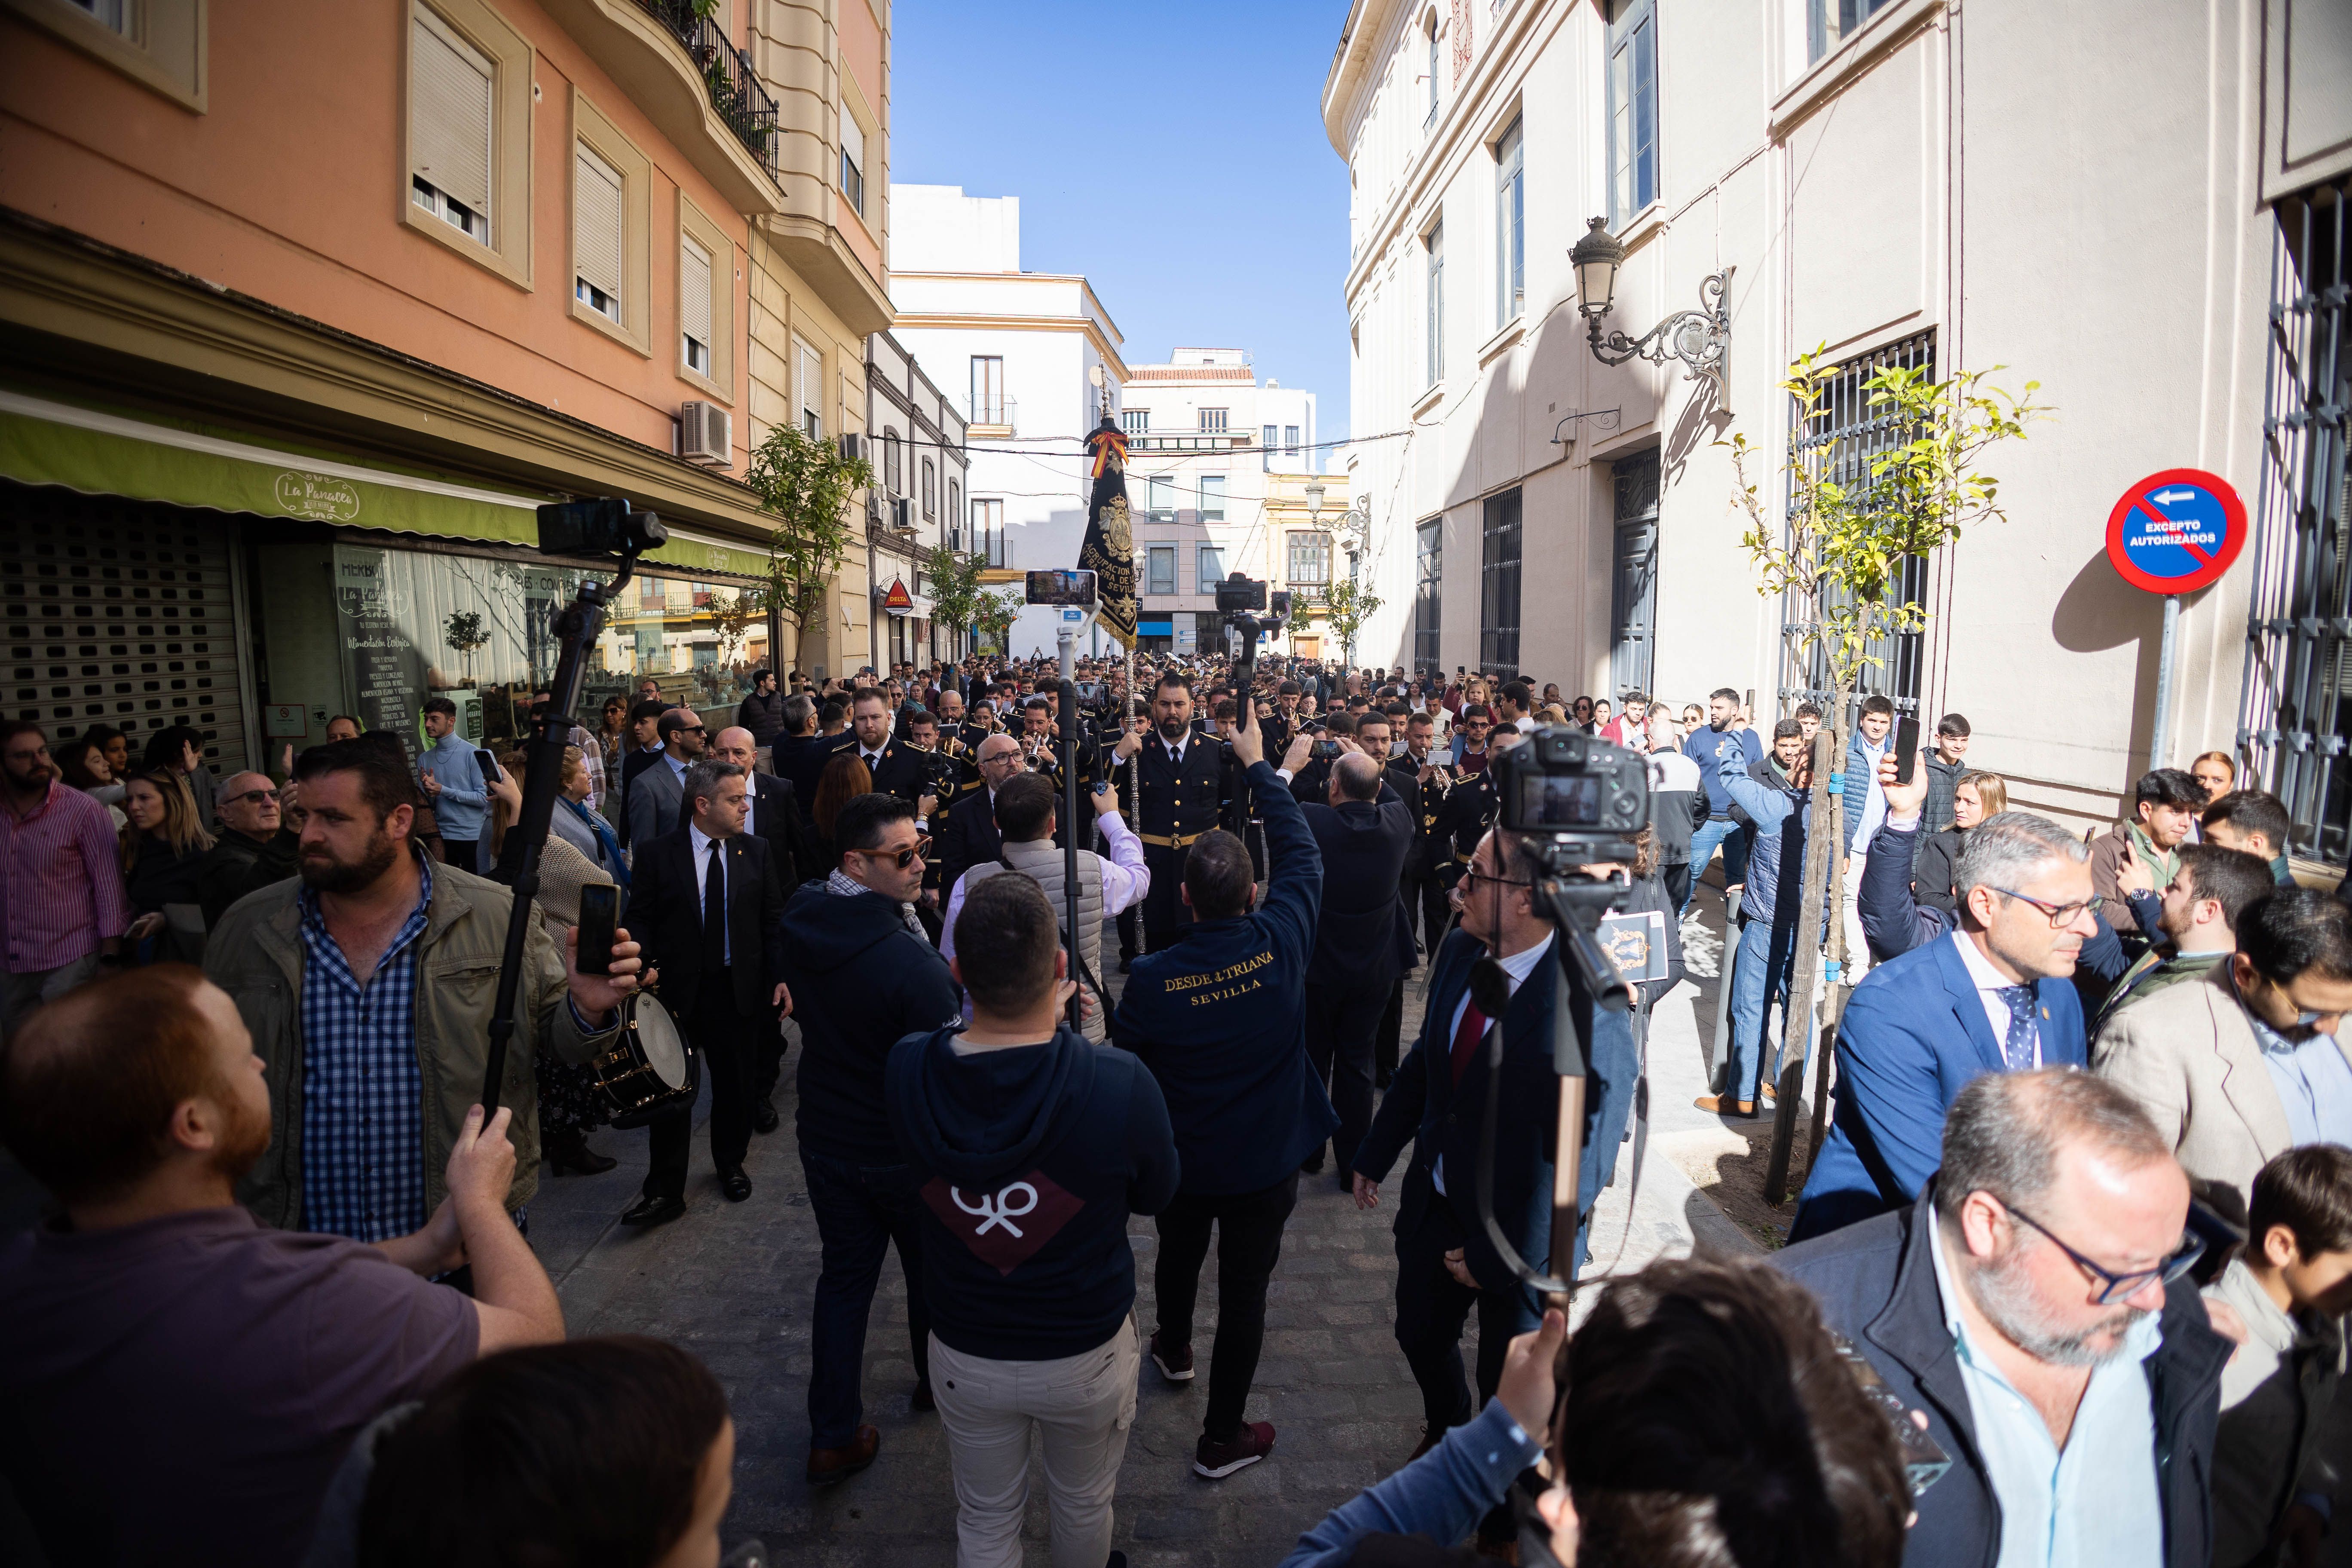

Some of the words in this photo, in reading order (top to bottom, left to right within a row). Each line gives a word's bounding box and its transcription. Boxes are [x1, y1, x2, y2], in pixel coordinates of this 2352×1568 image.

[285, 482, 302, 496] La
[304, 481, 353, 504] Panacea
[2145, 520, 2201, 533] EXCEPTO
[2129, 533, 2216, 547] AUTORIZADOS
[1085, 543, 1130, 575] AGRUPACION
[1099, 569, 1115, 582] SRA
[395, 719, 411, 727] INFUSIONES
[1164, 974, 1213, 992] DESDE
[1223, 951, 1274, 980] TRIANA
[1191, 979, 1262, 1006] SEVILLA
